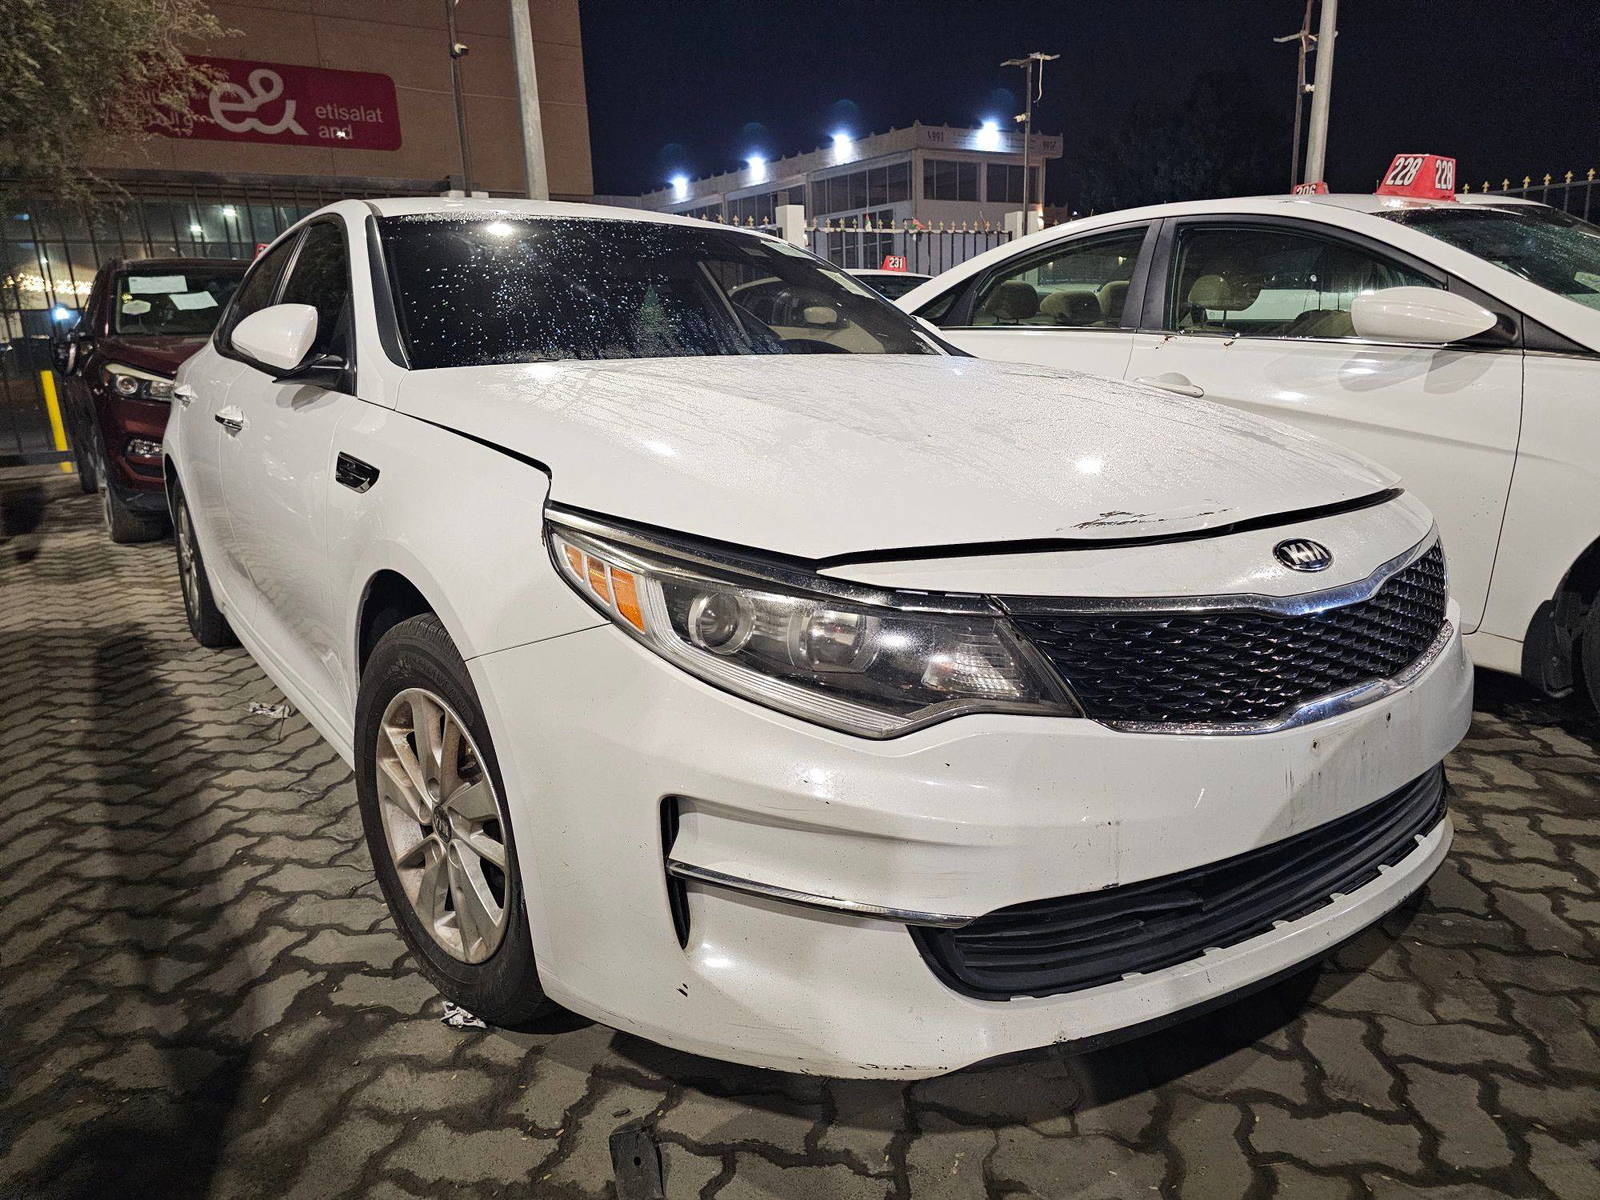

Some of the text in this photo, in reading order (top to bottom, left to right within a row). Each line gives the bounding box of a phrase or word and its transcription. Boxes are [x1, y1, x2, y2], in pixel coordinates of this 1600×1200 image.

[314, 103, 384, 124] etisalat
[318, 124, 353, 140] and
[1385, 157, 1424, 186] 228
[1435, 159, 1454, 190] 228
[888, 257, 903, 269] 231
[1280, 541, 1329, 565] KIA
